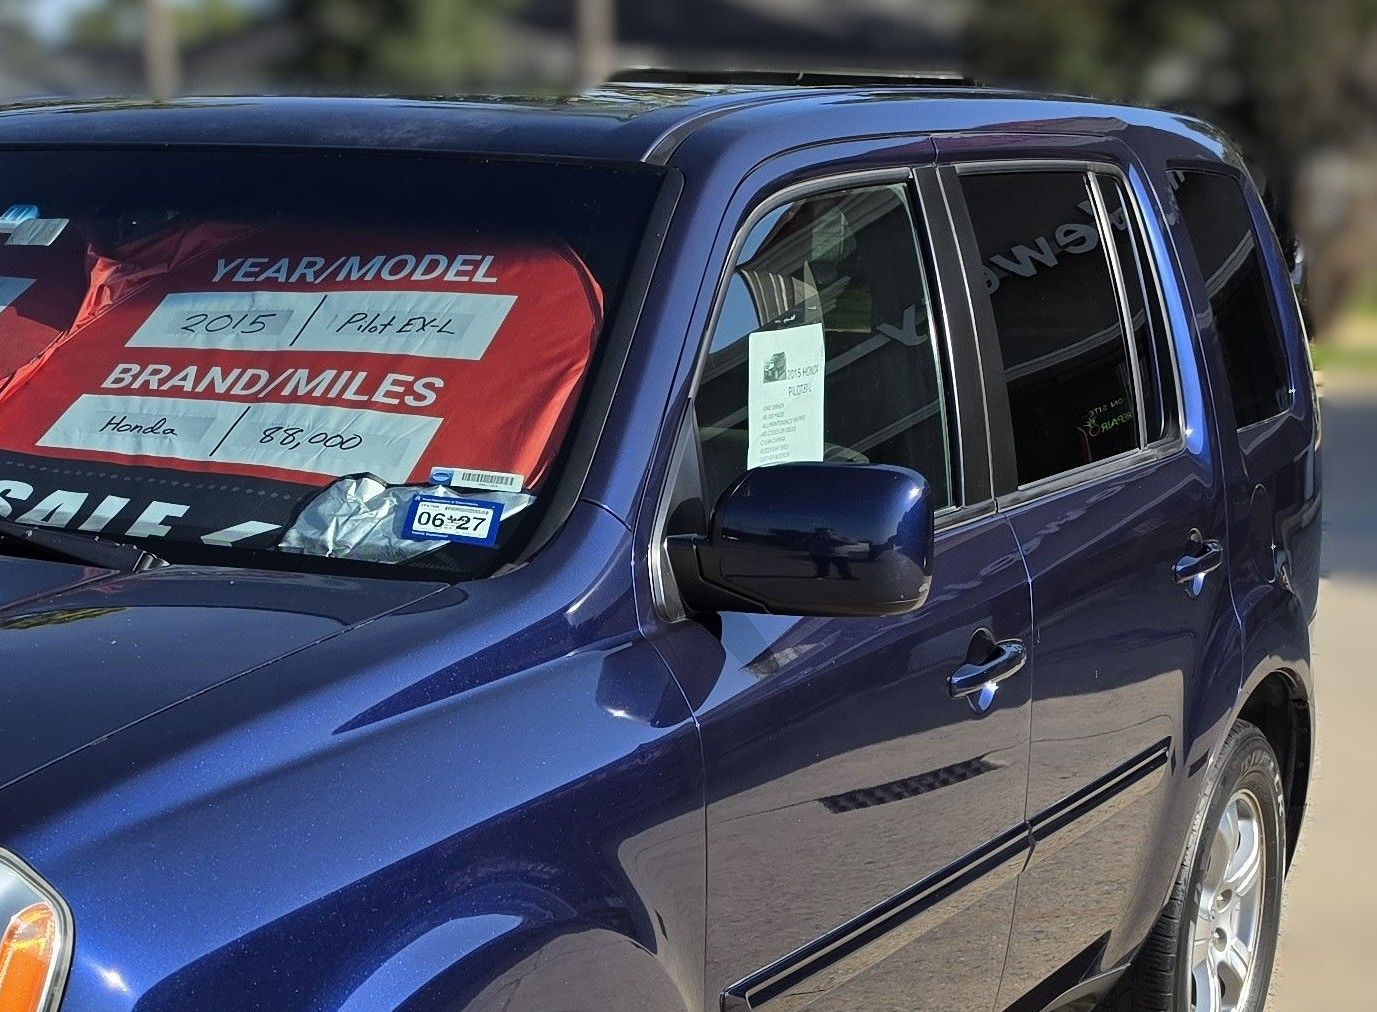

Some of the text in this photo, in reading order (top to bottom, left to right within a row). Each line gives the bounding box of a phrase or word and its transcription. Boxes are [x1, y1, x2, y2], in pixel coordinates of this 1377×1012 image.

[211, 253, 499, 284] YEAR/MODEL
[181, 312, 456, 335] 2015 Pilot EX-L
[101, 362, 446, 408] BRAND/MILES
[99, 415, 364, 452] Honda 88,000
